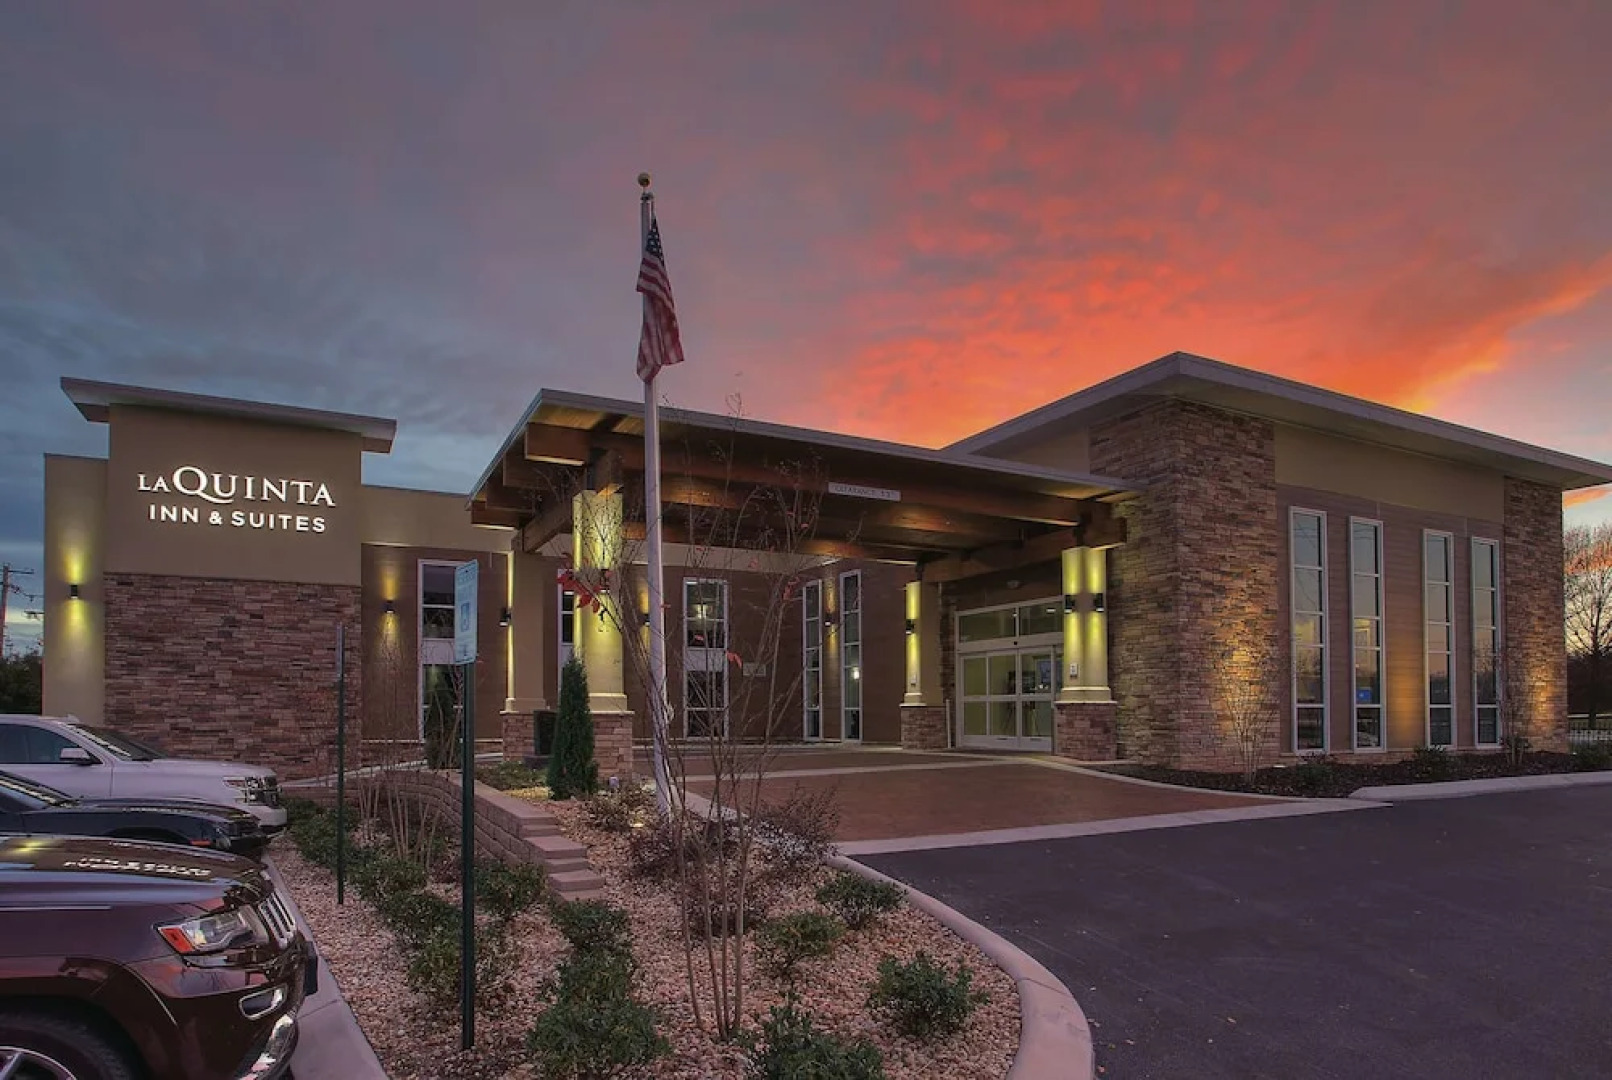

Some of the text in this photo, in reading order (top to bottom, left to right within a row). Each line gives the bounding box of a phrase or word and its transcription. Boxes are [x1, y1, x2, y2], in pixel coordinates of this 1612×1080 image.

[138, 466, 336, 507] LA QUINTA
[149, 504, 326, 533] INN & SUITES
